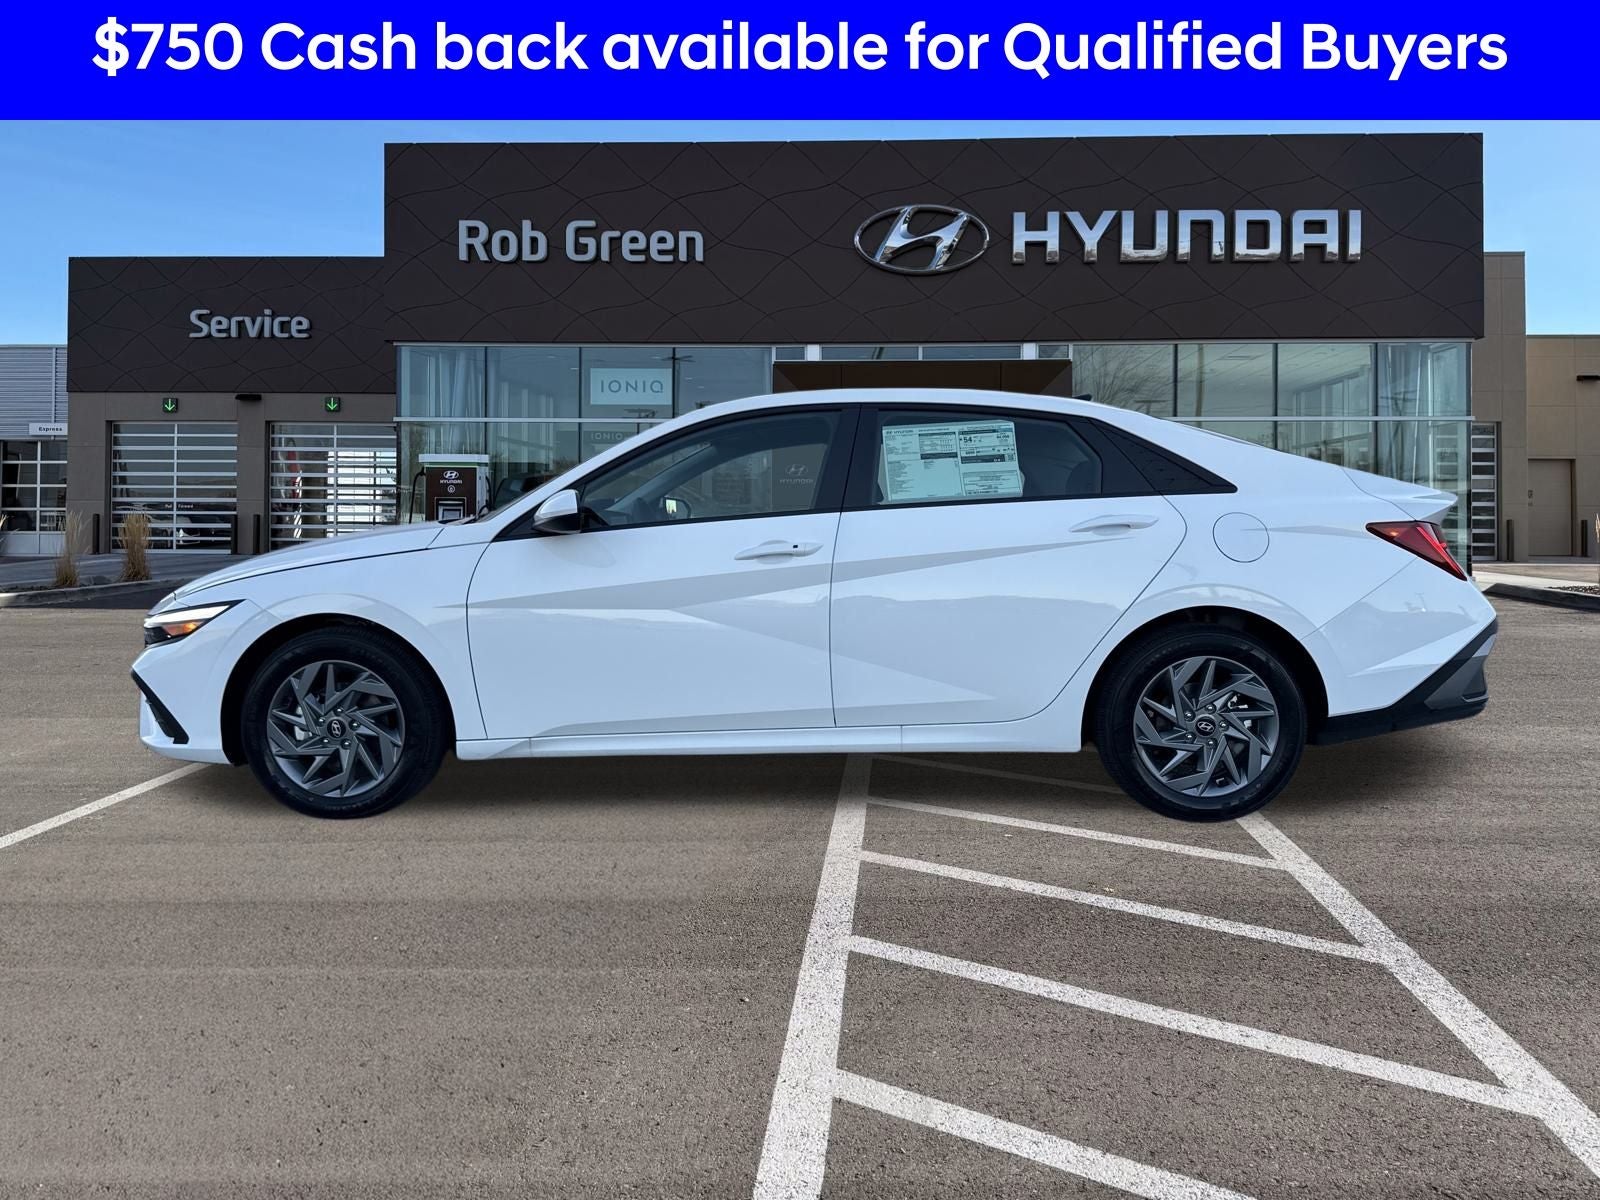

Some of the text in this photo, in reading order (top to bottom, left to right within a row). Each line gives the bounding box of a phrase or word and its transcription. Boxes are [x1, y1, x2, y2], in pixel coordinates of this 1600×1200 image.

[458, 219, 704, 262] Rob Green
[1011, 209, 1363, 263] HYUNDAI
[189, 308, 310, 339] Service
[601, 380, 663, 393] IONIQ
